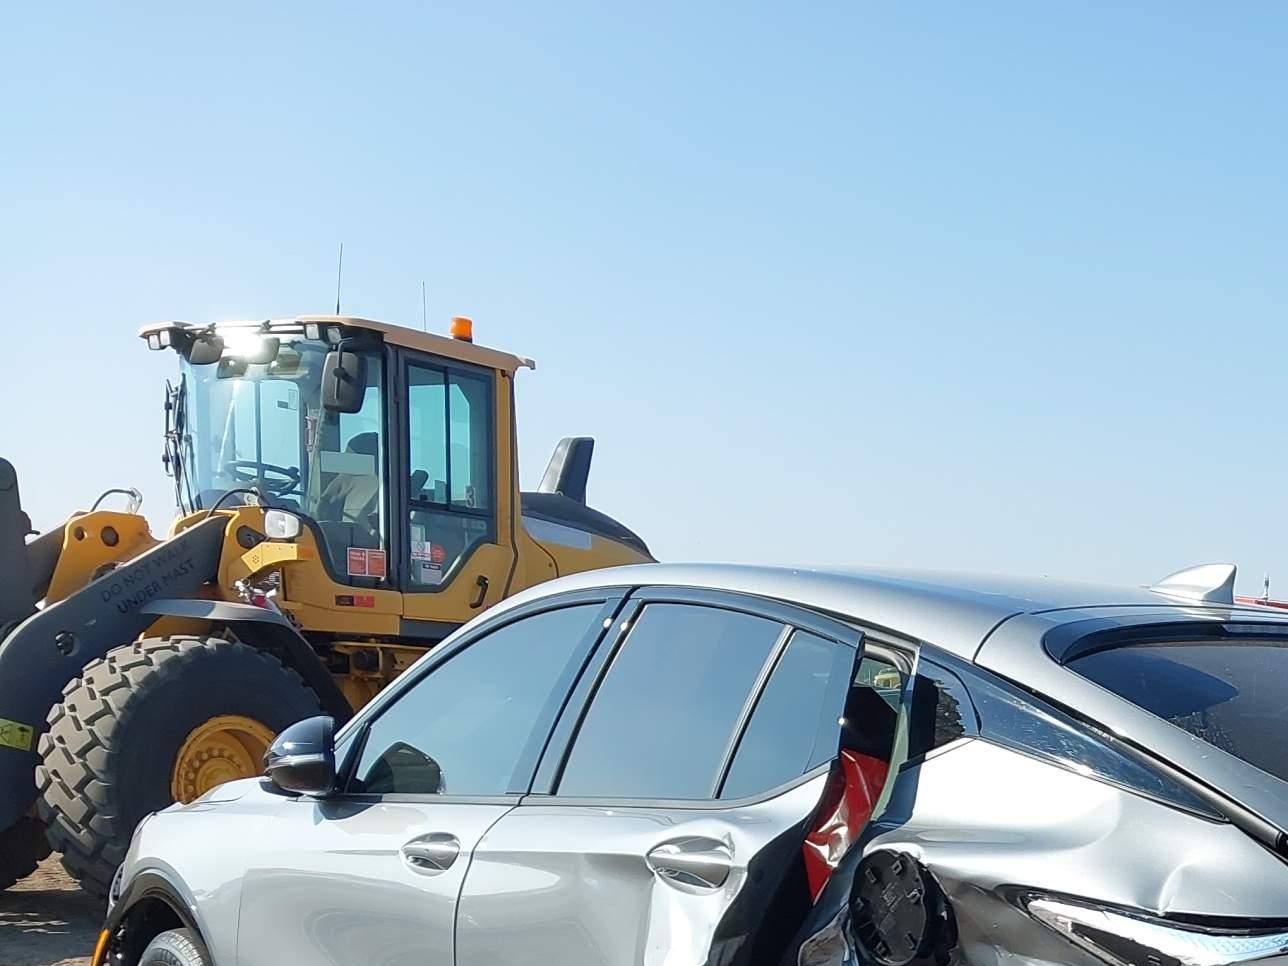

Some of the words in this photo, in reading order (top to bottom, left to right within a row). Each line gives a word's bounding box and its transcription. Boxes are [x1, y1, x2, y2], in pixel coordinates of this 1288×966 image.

[101, 583, 121, 602] DO
[123, 563, 151, 587] NOT
[117, 580, 161, 613] UNDER
[161, 558, 194, 587] MAST
